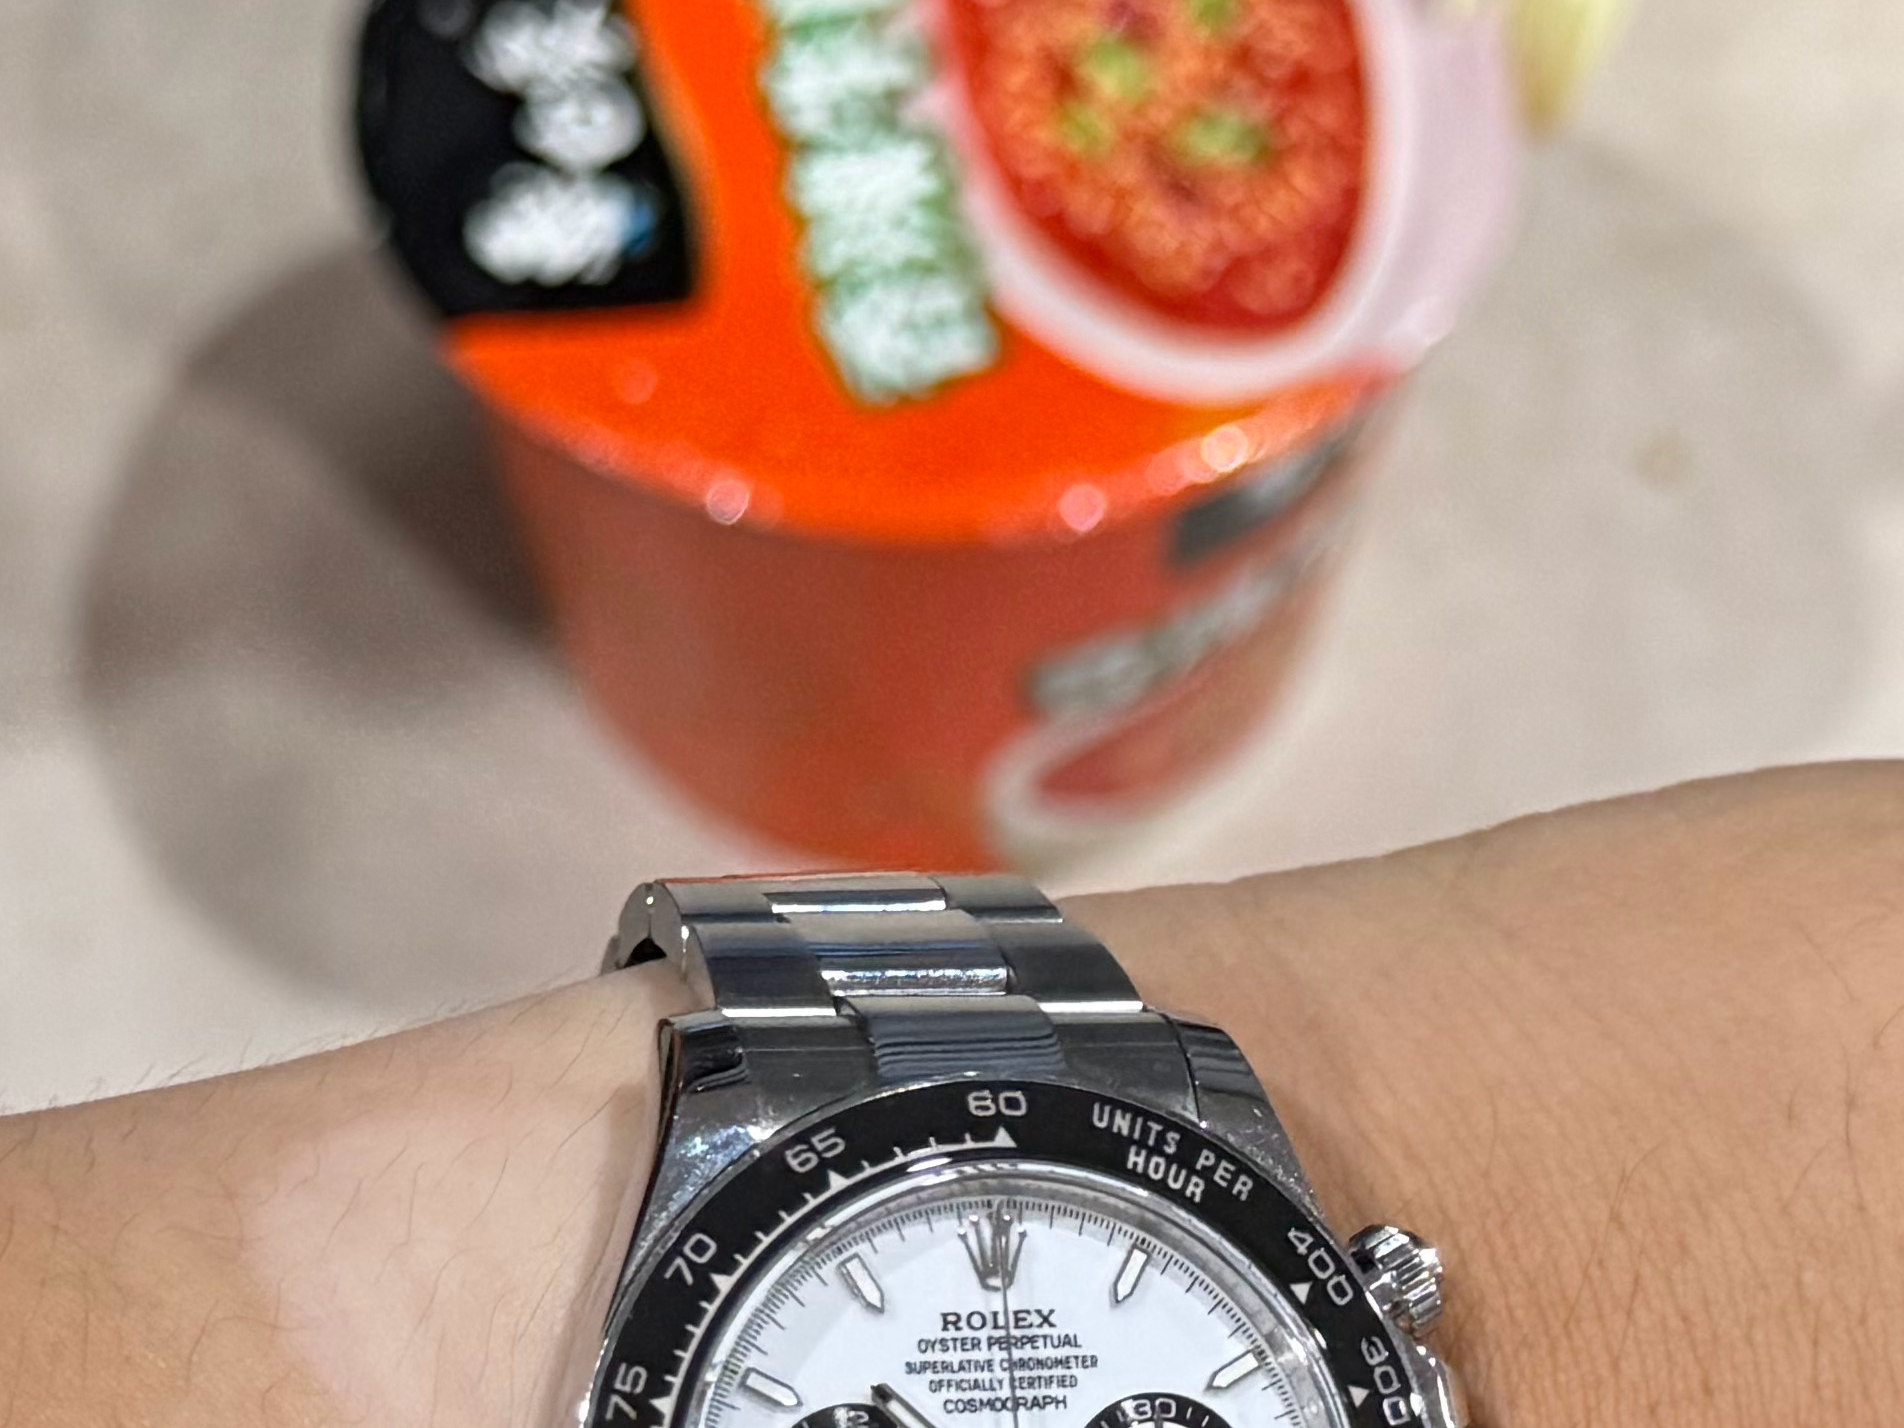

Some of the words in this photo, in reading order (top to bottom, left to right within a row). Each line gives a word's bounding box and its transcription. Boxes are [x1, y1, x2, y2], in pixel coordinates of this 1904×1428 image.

[966, 1089, 1028, 1117] 60
[784, 1126, 846, 1174] 65
[1092, 1102, 1181, 1155] UNITS
[1196, 1149, 1254, 1201] PER
[1127, 1145, 1206, 1203] HOUR
[663, 1232, 718, 1287] 70
[1287, 1227, 1353, 1306] 400
[940, 1308, 1058, 1332] ROLEX
[917, 1336, 983, 1354] OYSTER
[986, 1333, 1083, 1353] PERPETUAL
[904, 1359, 995, 1375] SUPERLATIVE
[999, 1354, 1099, 1372] CHRONOMETER
[1360, 1335, 1411, 1427] 300
[605, 1361, 649, 1421] 75
[928, 1376, 1005, 1394] OFFICIALLY
[942, 1394, 1068, 1414] COSMOGRAPH
[1129, 1397, 1177, 1420] 30
